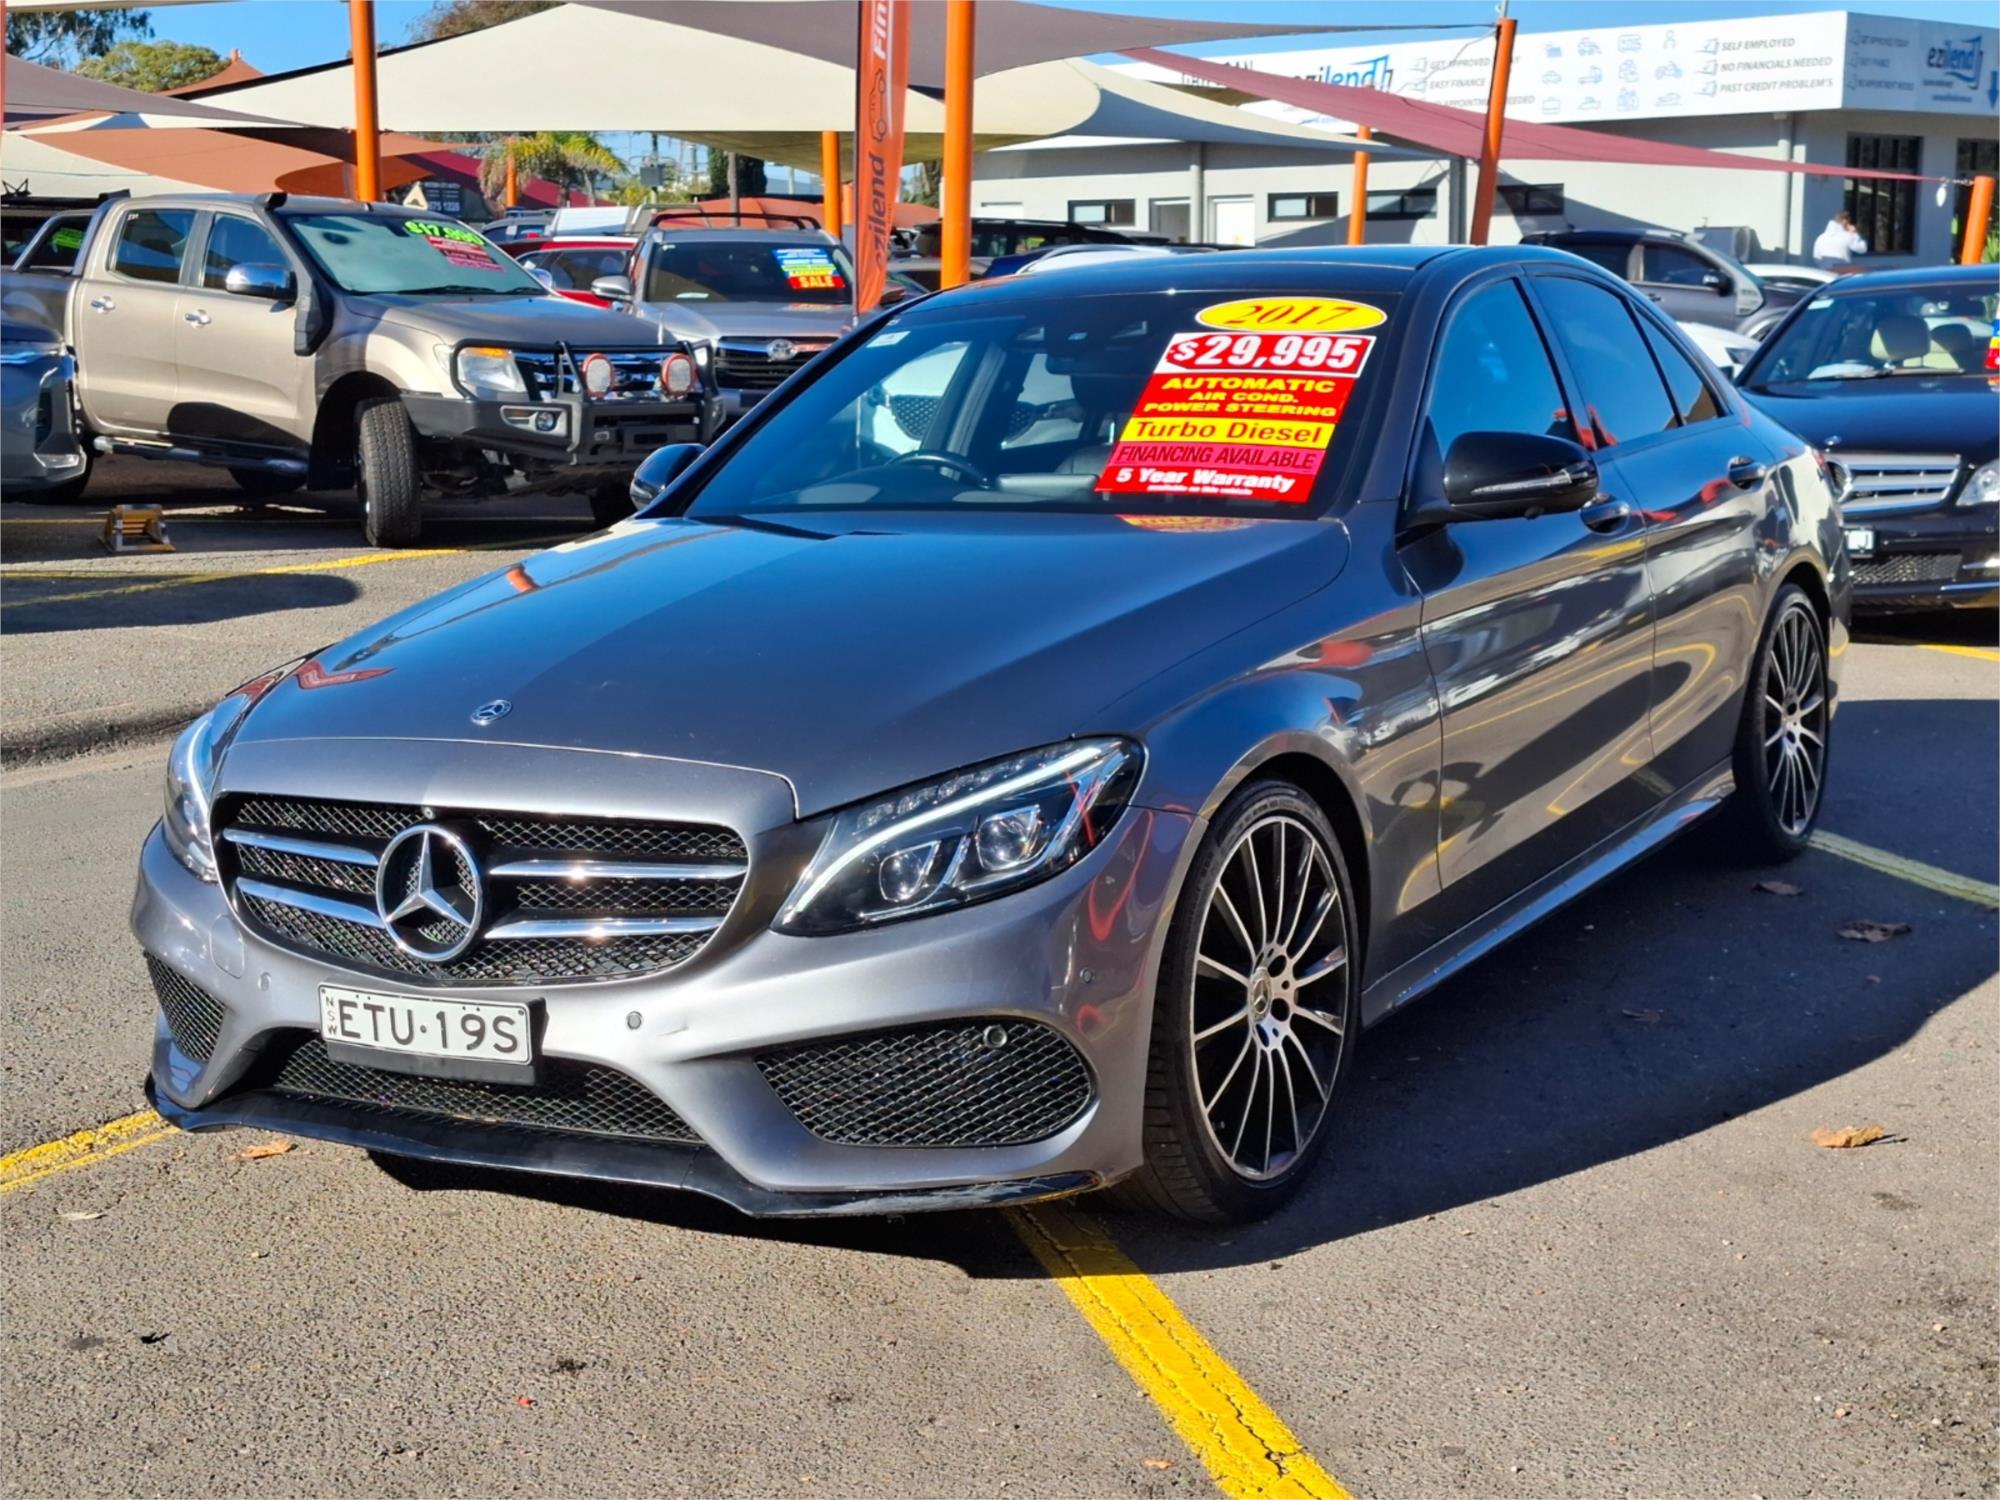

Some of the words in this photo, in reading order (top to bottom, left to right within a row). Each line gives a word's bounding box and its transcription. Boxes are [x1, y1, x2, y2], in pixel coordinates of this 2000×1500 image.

[1721, 41, 1743, 51] SELF
[1744, 38, 1796, 49] EMPLOYED
[1720, 62, 1735, 72] NO
[1736, 58, 1791, 71] FINANCIALS
[1792, 57, 1833, 68] NEEDED
[1720, 82, 1742, 93] PAST
[1743, 80, 1777, 92] CREDIT
[1507, 95, 1537, 105] EEDED
[799, 276, 835, 288] SALE
[1225, 304, 1358, 325] 2017
[1171, 335, 1363, 369] $29,995
[1162, 377, 1336, 393] AUTOMATIC
[1189, 391, 1226, 401] AIR
[1232, 392, 1299, 403] COND.
[1144, 402, 1220, 413] POWER
[1225, 403, 1337, 416] STEERING
[1136, 421, 1216, 438] Turbo
[1227, 422, 1322, 442] Diesel
[1116, 446, 1212, 463] FINANCING
[1214, 448, 1317, 470] AVAILABLE
[1116, 468, 1134, 483] 5
[1139, 468, 1187, 484] Year
[1192, 469, 1296, 493] Warranty
